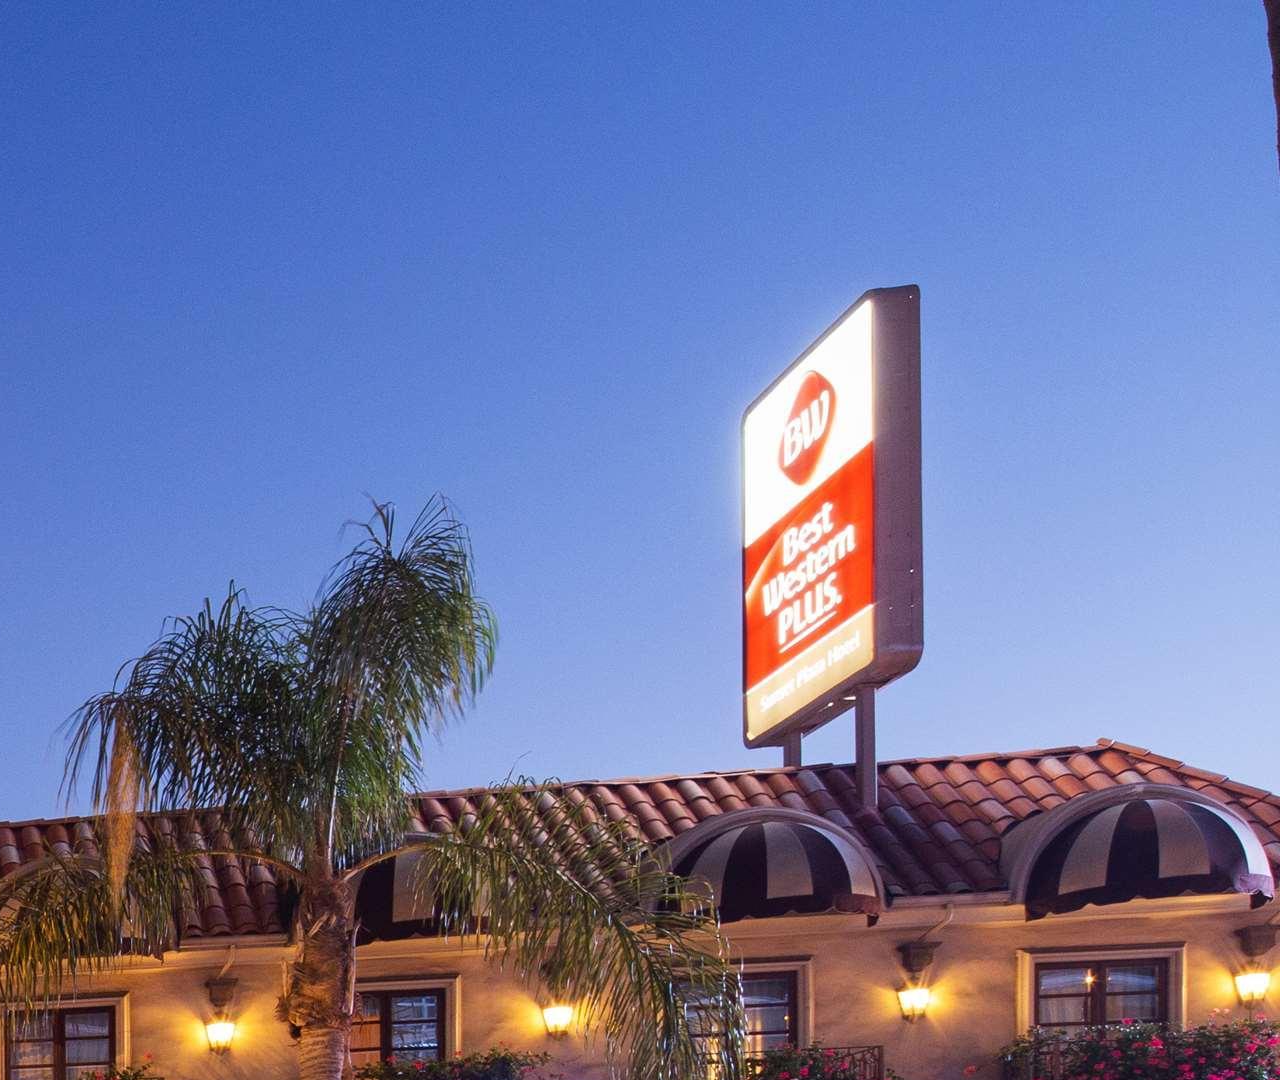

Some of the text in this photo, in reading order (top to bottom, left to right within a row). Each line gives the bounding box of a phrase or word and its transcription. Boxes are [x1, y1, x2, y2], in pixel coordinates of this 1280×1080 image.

[783, 389, 831, 468] BW
[762, 524, 856, 617] Western
[782, 501, 835, 567] Best
